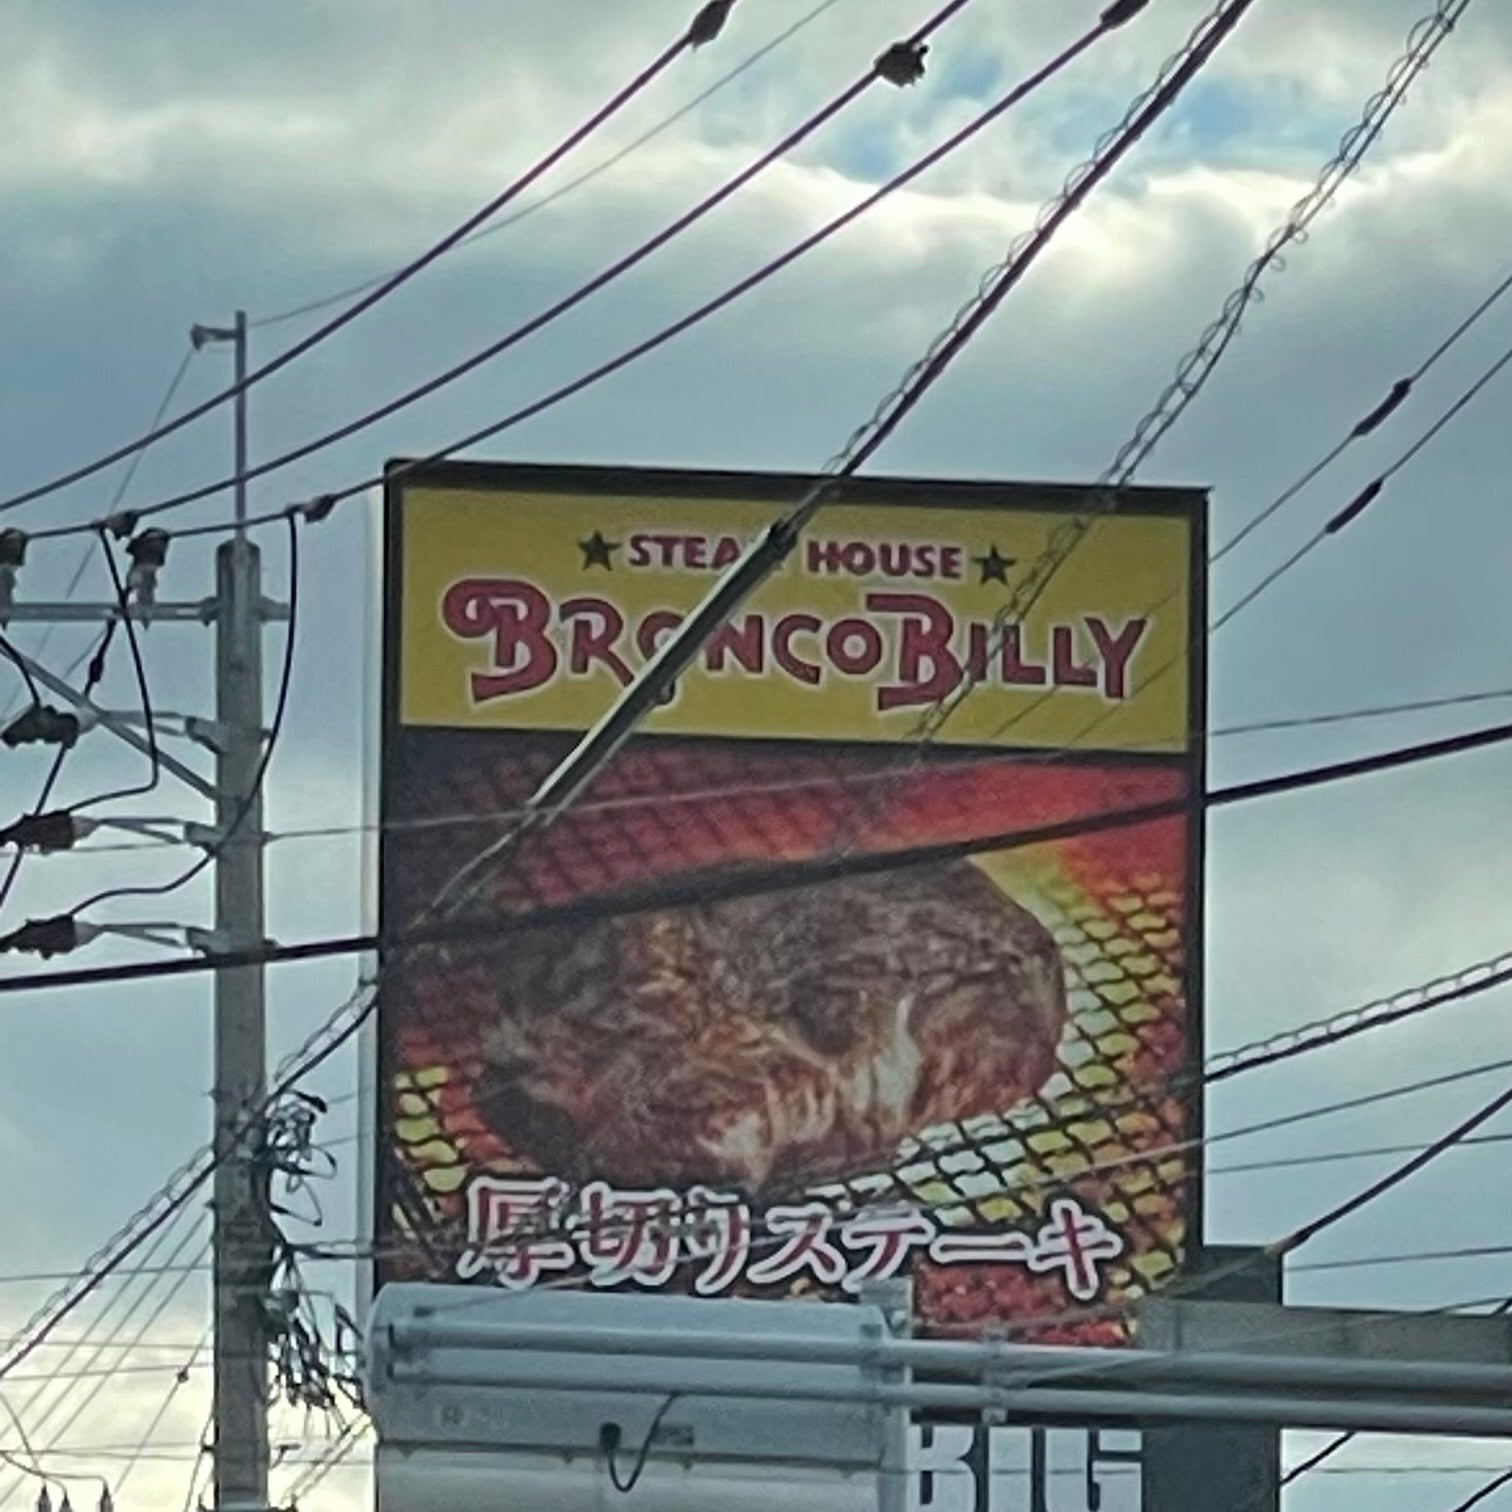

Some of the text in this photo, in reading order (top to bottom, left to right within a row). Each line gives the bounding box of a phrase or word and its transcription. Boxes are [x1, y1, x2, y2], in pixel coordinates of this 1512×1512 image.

[629, 533, 963, 579] STEA HOUSE
[457, 1176, 1123, 1300] 厚切りステーキ
